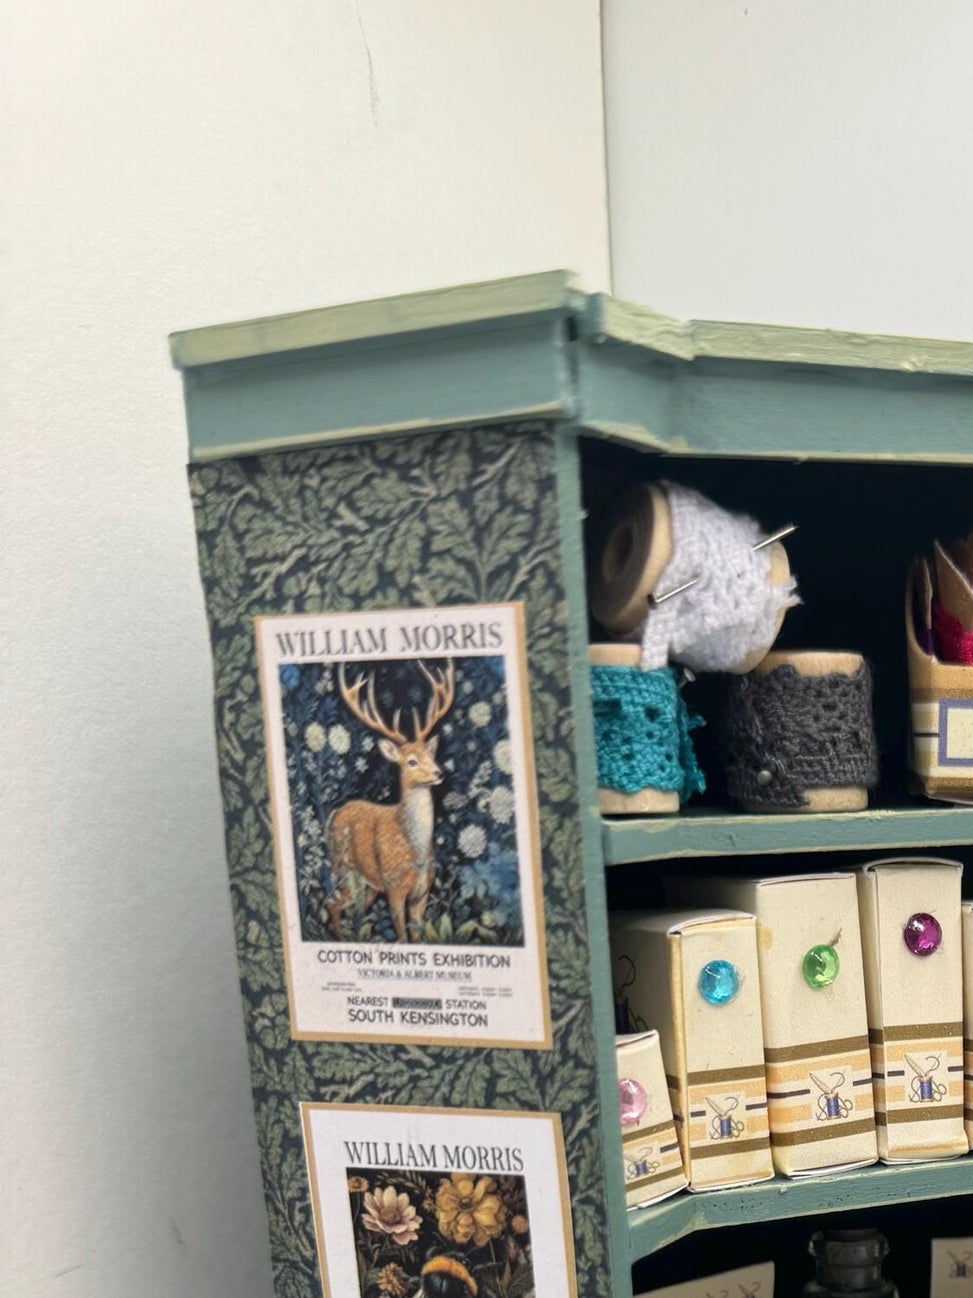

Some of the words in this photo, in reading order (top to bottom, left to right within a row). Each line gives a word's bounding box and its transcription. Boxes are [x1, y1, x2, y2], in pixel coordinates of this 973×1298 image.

[276, 627, 387, 657] WILLIAM
[400, 622, 504, 652] MORRIS
[317, 950, 373, 964] COTTON
[379, 951, 427, 966] PRINTS
[433, 953, 511, 968] EXHIBITION
[347, 997, 388, 1007] NEAREST
[445, 999, 486, 1010] STATION
[348, 1009, 394, 1024] SOUTH
[400, 1011, 488, 1027] KENSINGTON
[344, 1141, 439, 1169] WILLIAM
[441, 1144, 524, 1172] MORRIS
